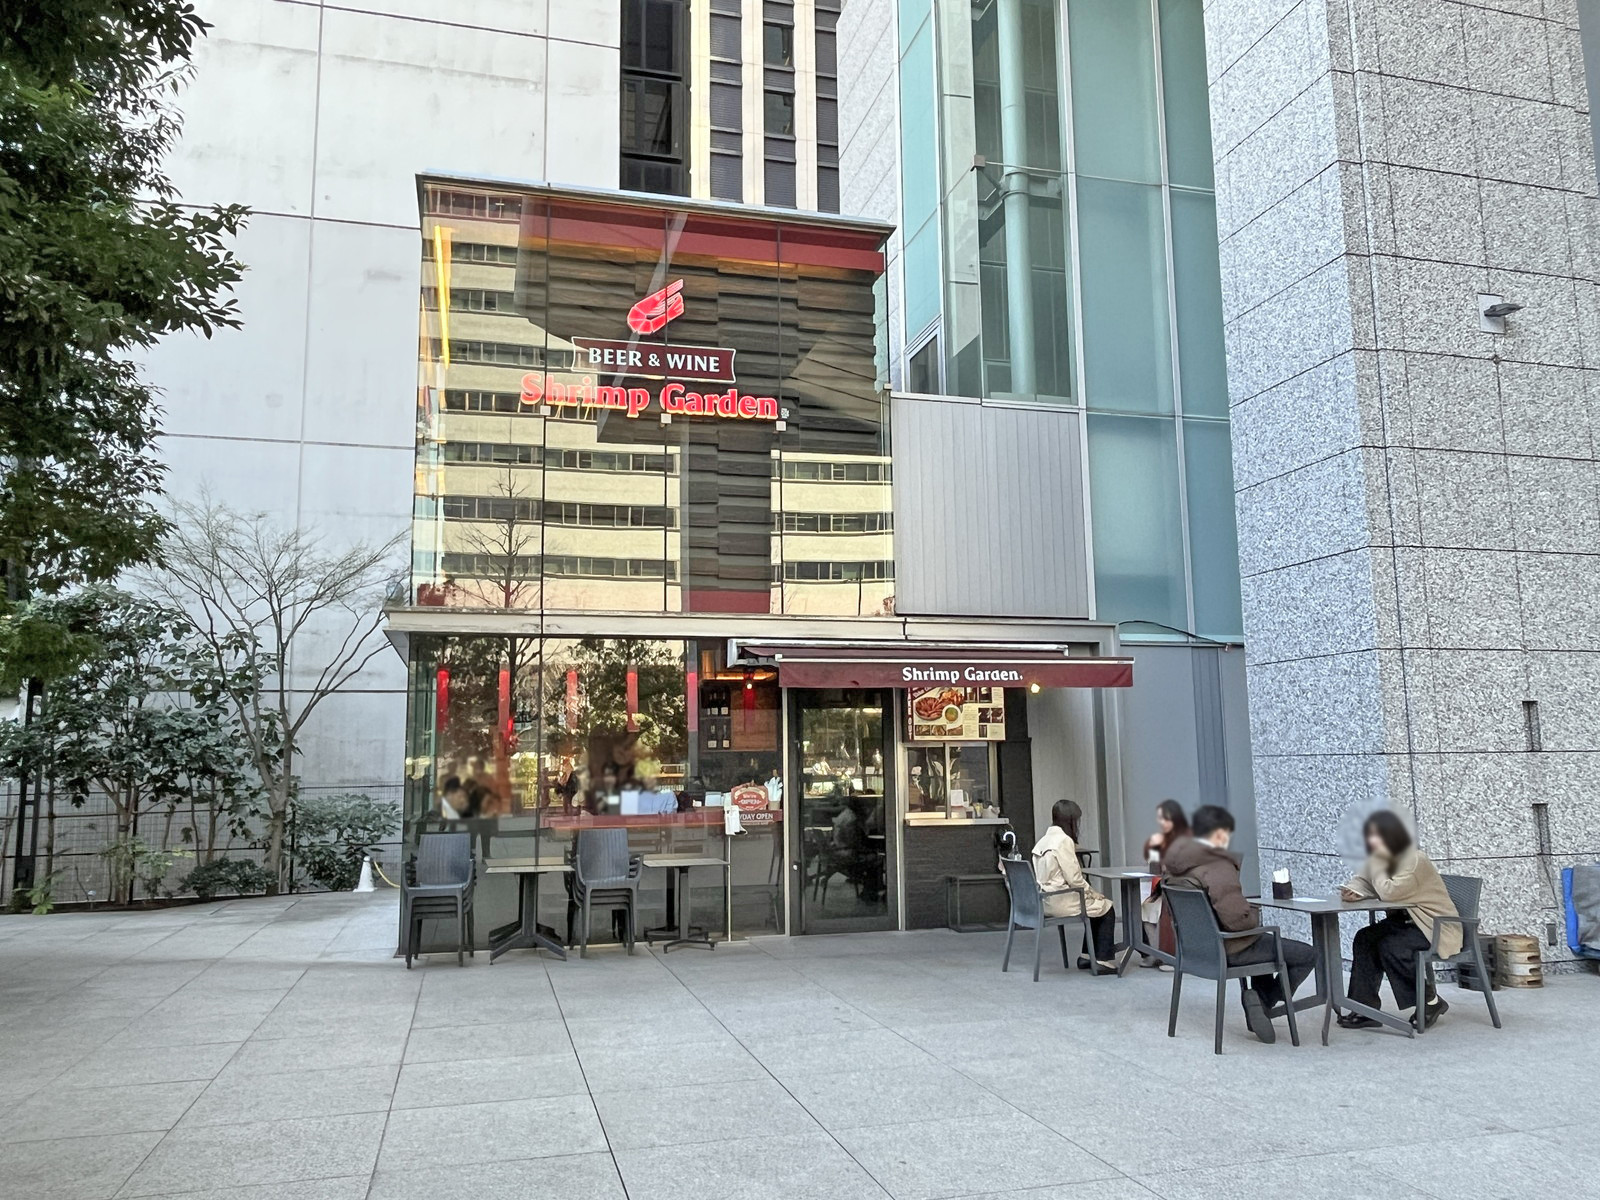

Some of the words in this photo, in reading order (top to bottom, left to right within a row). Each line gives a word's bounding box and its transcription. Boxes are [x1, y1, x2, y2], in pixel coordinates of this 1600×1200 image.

[589, 347, 642, 367] BEER
[648, 353, 661, 367] &
[666, 353, 720, 372] WINE
[520, 373, 650, 418] Shrimp
[659, 383, 778, 419] Garden
[902, 666, 960, 683] Shrimp
